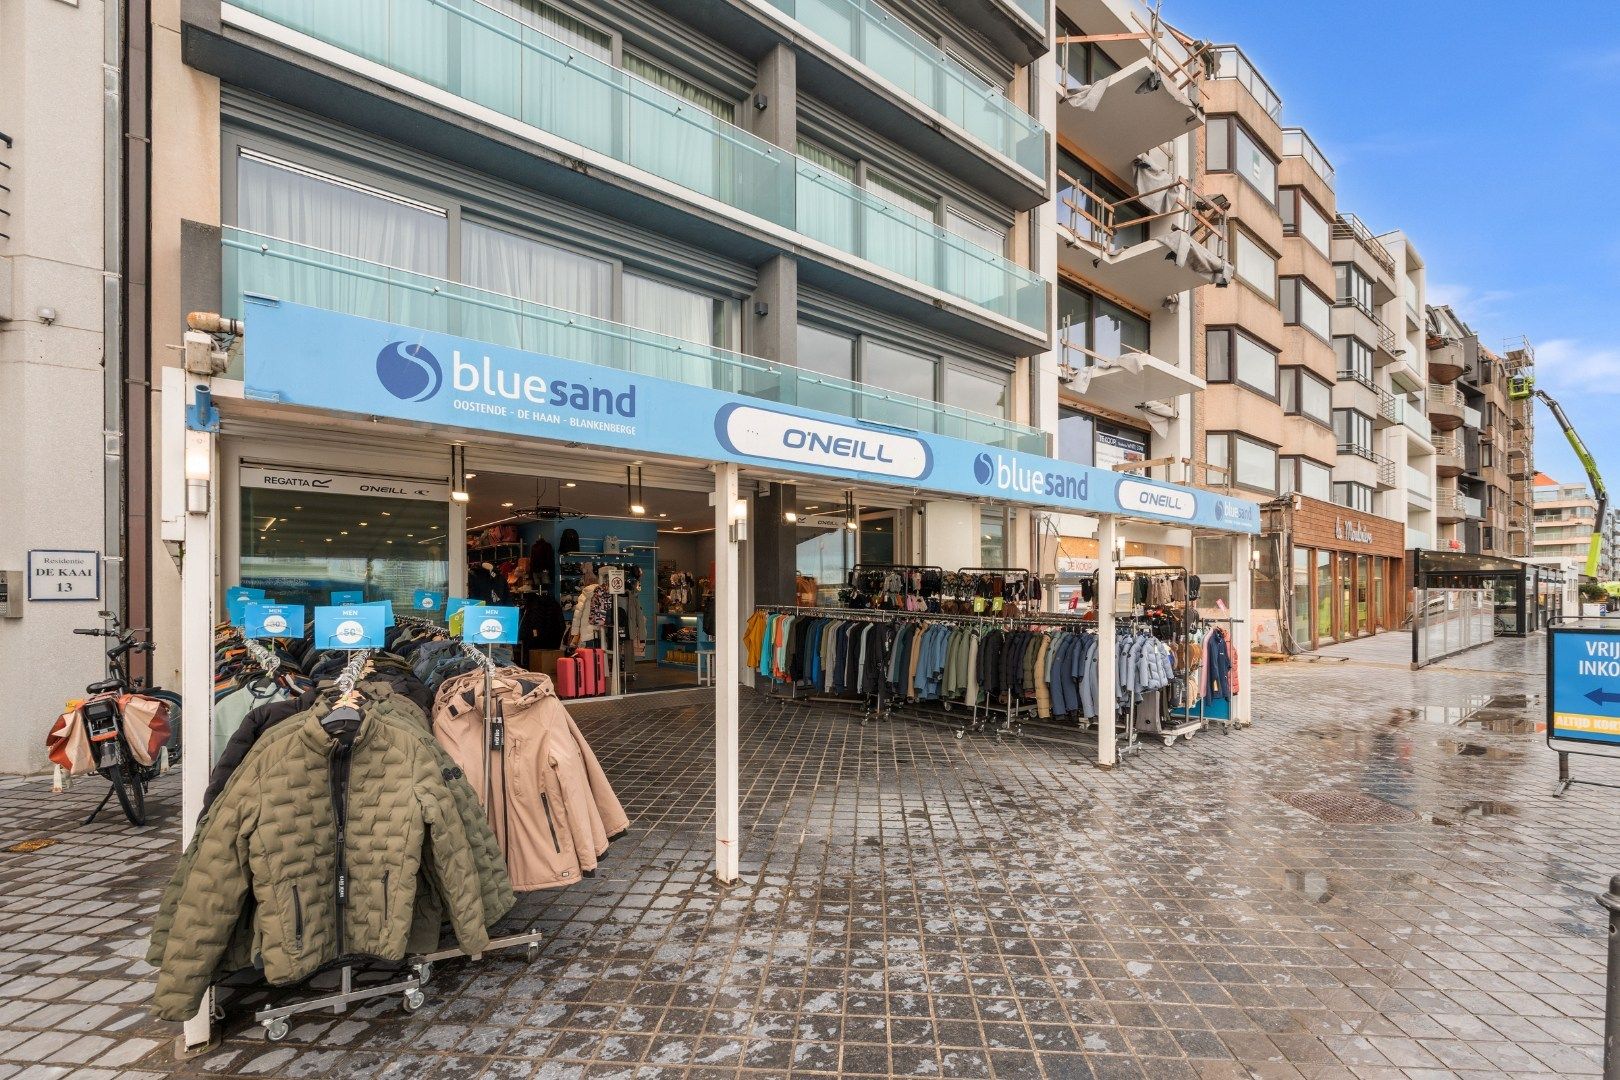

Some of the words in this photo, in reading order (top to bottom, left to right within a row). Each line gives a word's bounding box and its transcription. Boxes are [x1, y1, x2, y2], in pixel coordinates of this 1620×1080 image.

[453, 399, 508, 417] OOSTENDE
[517, 409, 530, 420] DE
[532, 412, 561, 424] HAAN
[569, 417, 637, 436] BLANKENBERGE
[782, 428, 893, 464] O'NEILL
[264, 476, 310, 487] REGATTA
[360, 485, 408, 495] O'NEILL
[1139, 491, 1182, 510] O'NEILL
[44, 557, 85, 565] Residentie
[36, 568, 55, 577] DE
[58, 568, 92, 577] KAAI
[57, 582, 73, 593] 13
